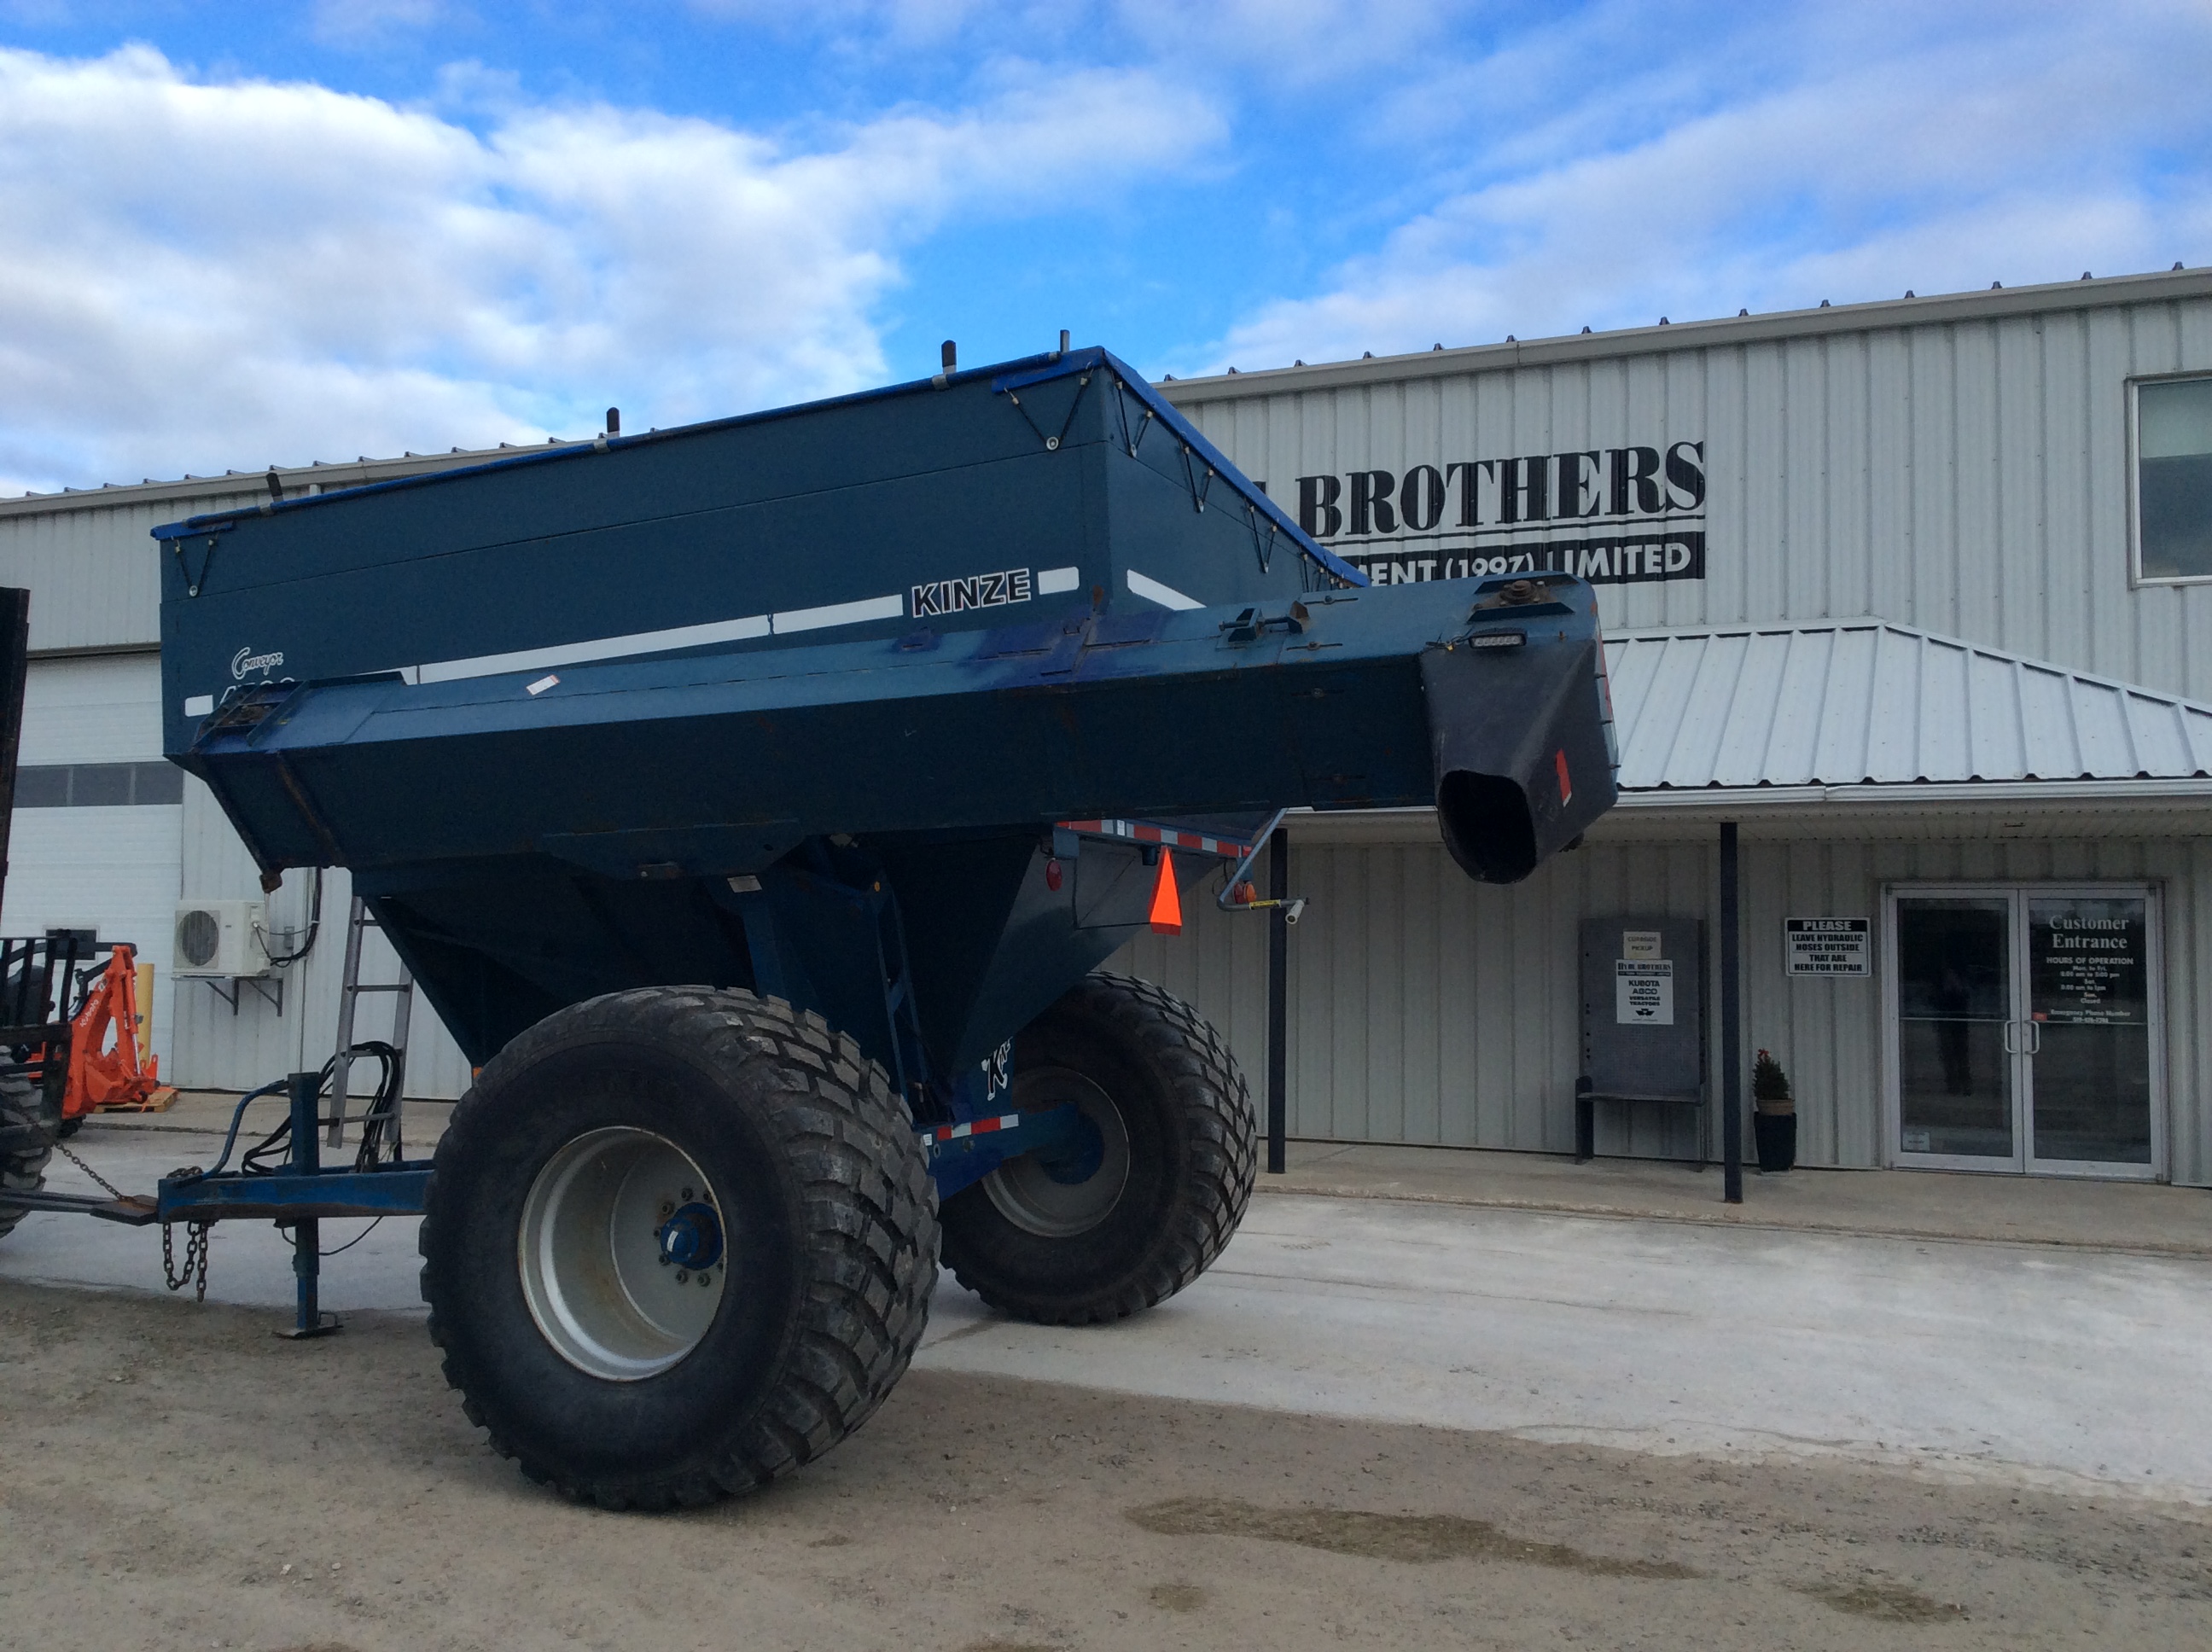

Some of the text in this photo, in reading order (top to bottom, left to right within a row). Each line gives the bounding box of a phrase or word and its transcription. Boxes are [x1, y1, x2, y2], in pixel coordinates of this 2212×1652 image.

[1295, 441, 1705, 538] BROTHERS
[911, 567, 1032, 618] KINZE
[231, 646, 284, 680] Conveyor
[1802, 921, 1853, 931] PLEASE
[2049, 915, 2129, 930] Customer
[2052, 934, 2128, 949] Entrance
